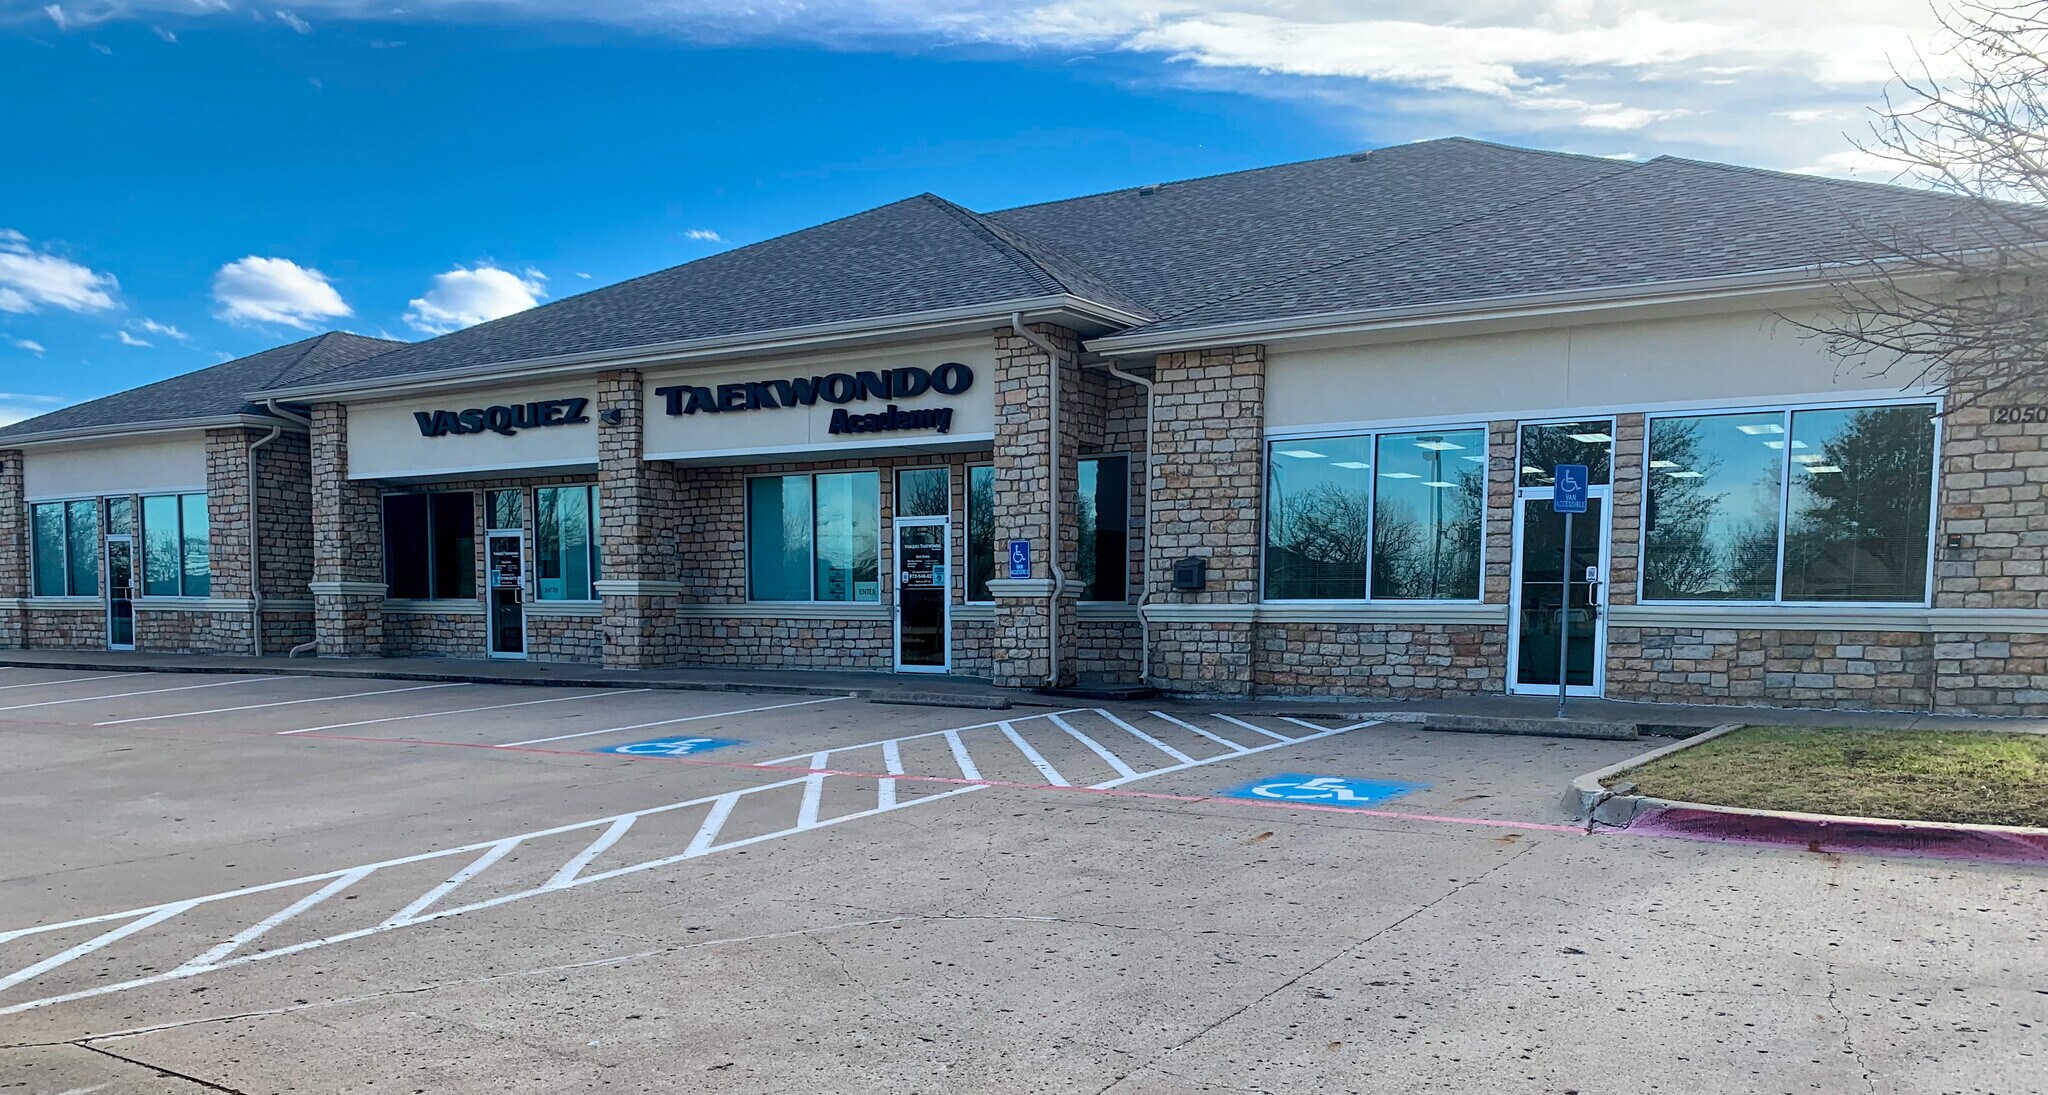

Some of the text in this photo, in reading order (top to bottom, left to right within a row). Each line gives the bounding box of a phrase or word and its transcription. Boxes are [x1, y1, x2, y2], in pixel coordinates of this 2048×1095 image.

[655, 362, 974, 416] TAEKWONDO
[413, 397, 590, 437] VASQUEZ
[828, 404, 954, 434] Academy
[1995, 406, 2048, 424] 2050
[1556, 500, 1585, 508] ACCESSIBLE
